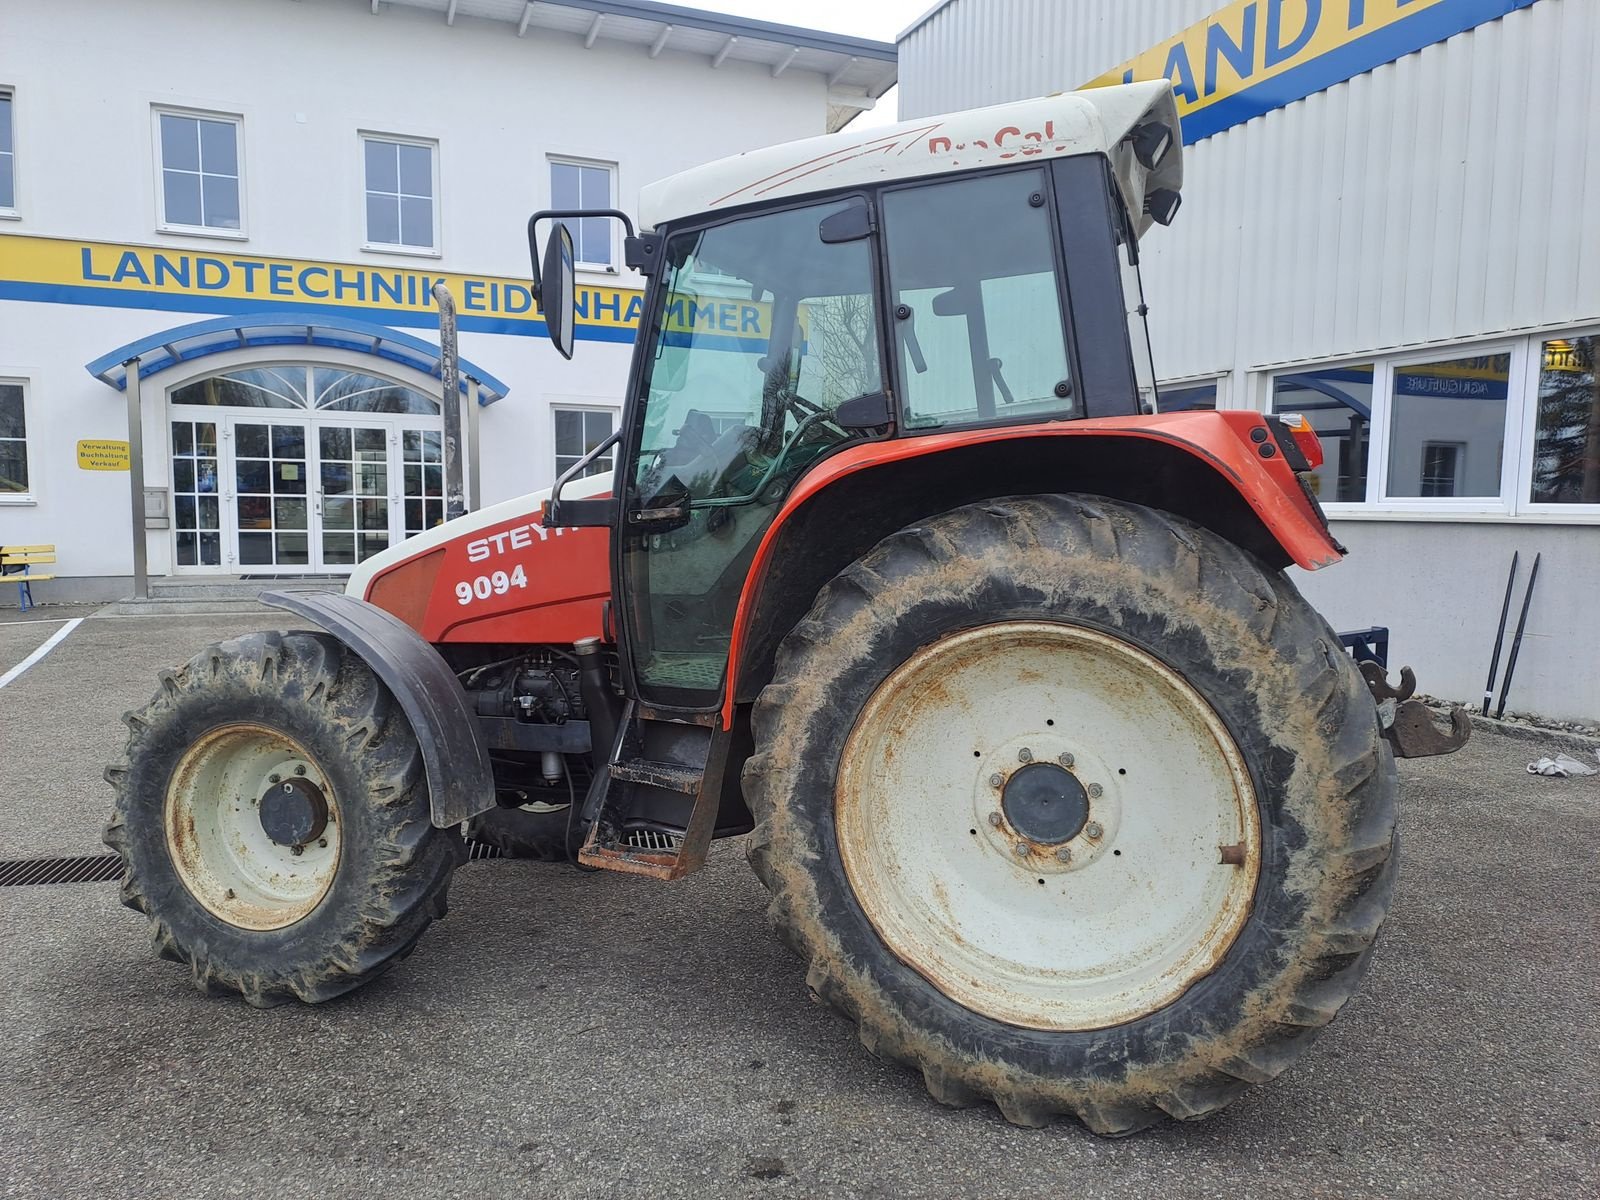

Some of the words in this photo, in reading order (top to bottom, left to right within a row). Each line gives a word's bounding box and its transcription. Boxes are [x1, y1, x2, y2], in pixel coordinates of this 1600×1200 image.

[1123, 0, 1414, 104] AND
[81, 247, 448, 306] LANDTECHNIK
[464, 280, 760, 333] EIDNHAMMER
[80, 452, 129, 460] Buchhaltung
[82, 443, 126, 452] Verwaltung
[467, 522, 579, 562] STEY
[455, 564, 527, 605] 9094
